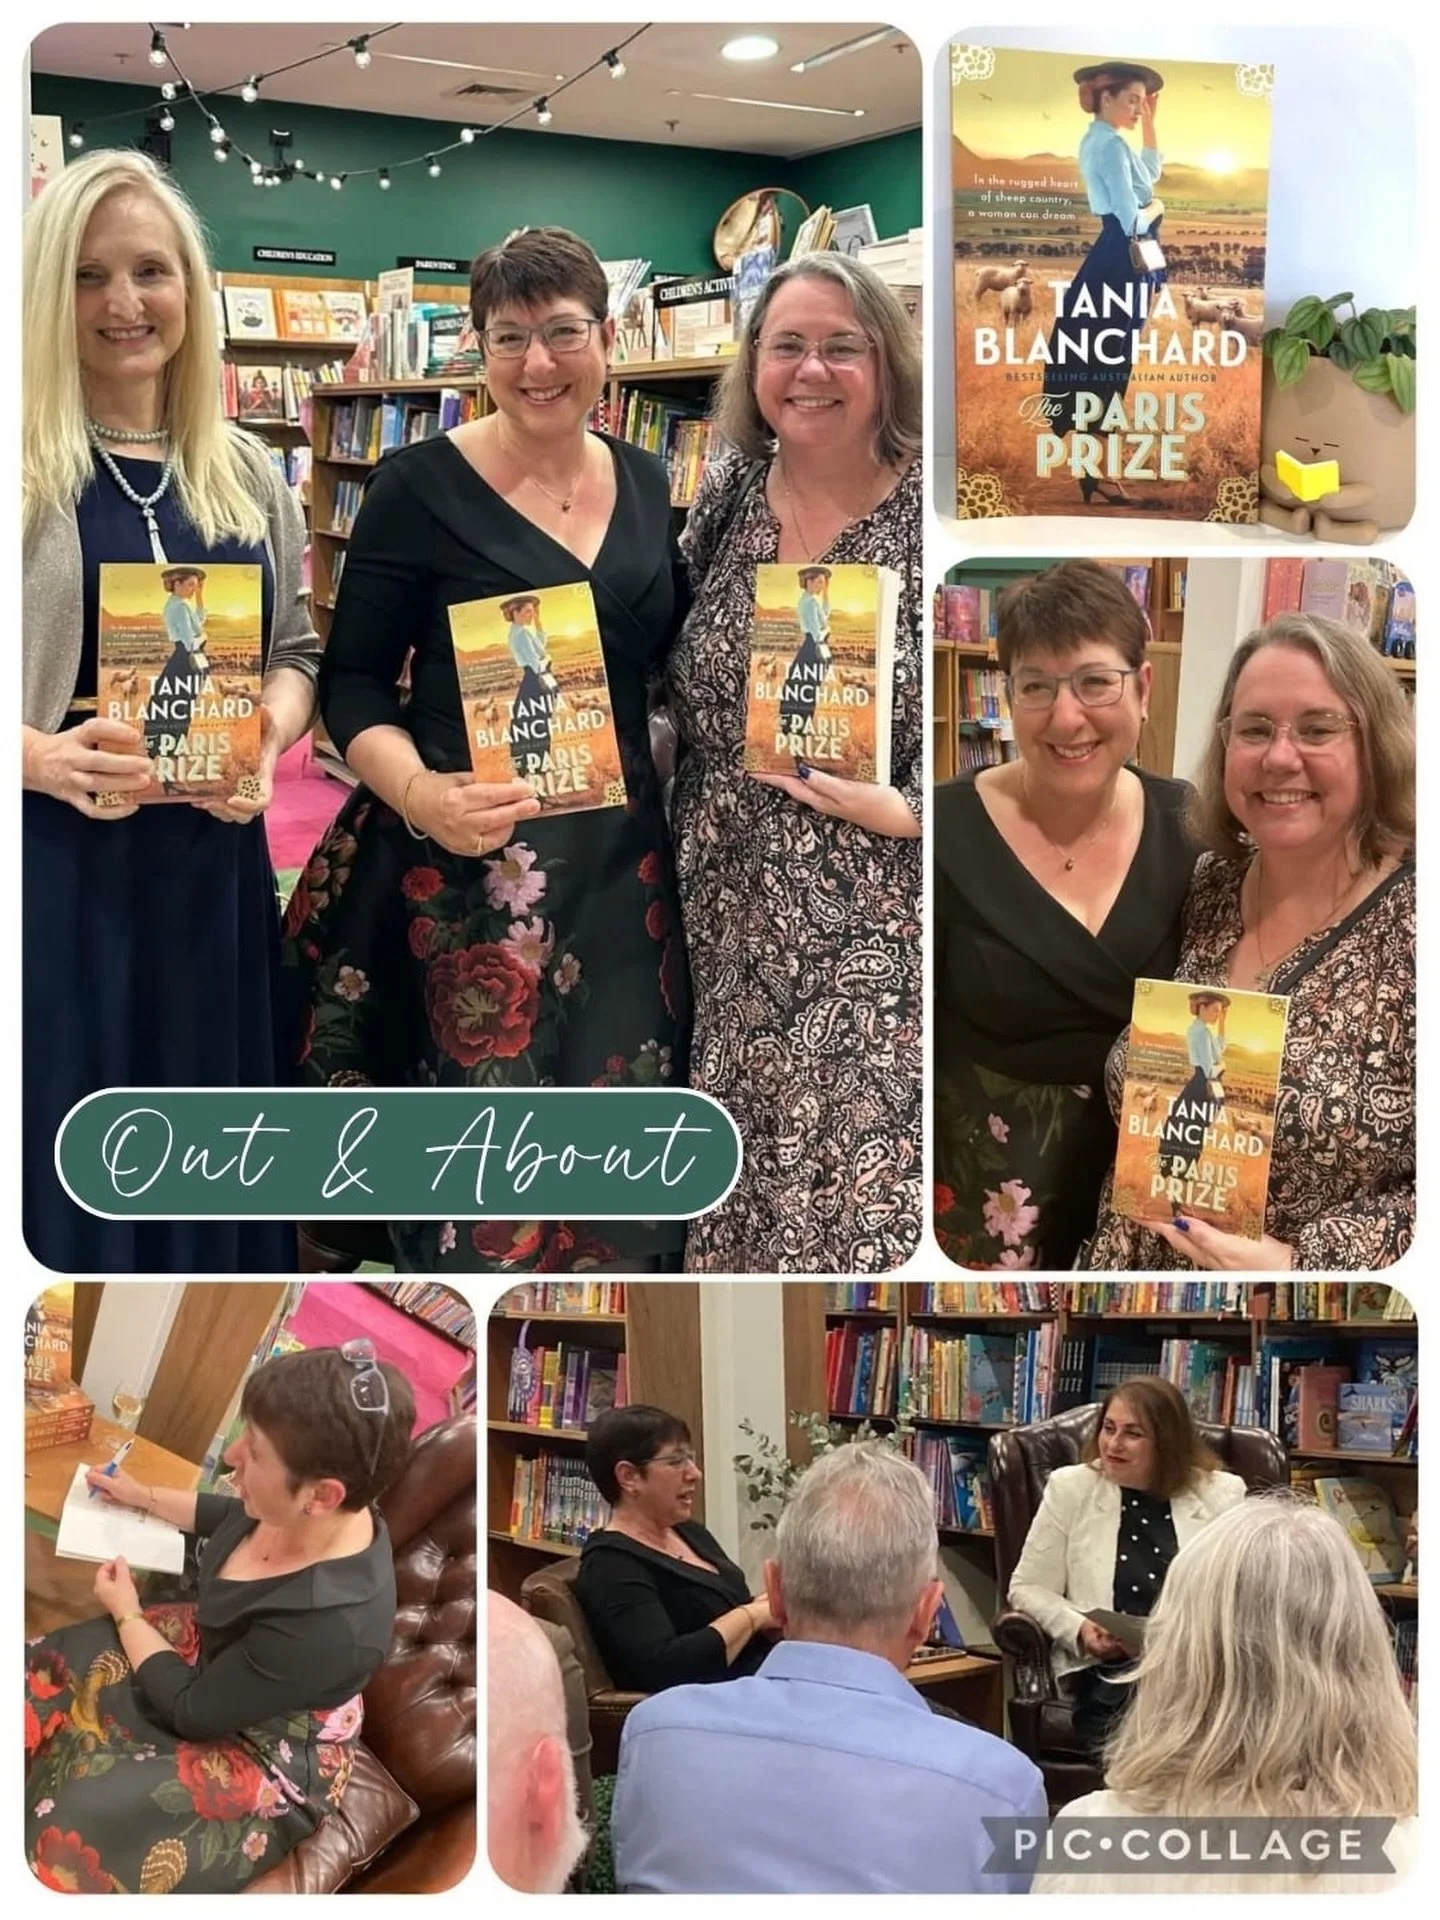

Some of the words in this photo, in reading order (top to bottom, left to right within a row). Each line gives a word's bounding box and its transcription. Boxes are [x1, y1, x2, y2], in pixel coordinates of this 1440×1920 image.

[974, 173, 985, 185] In
[988, 174, 1006, 186] the
[1009, 176, 1047, 189] rugged
[1050, 177, 1079, 189] heart
[980, 190, 992, 203] of
[995, 190, 1026, 204] sheep
[1029, 194, 1073, 206] country,
[968, 210, 976, 218] a
[979, 210, 1017, 219] woman
[1020, 211, 1040, 220] can
[1042, 208, 1077, 221] dream
[415, 260, 457, 270] PARENTING
[660, 280, 703, 300] CHILDREN'S
[1048, 280, 1178, 321] TANIA
[974, 327, 1248, 368] BLANCHARD
[1006, 372, 1090, 383] BESTSELLING
[1093, 372, 1165, 382] AUSTRALIAN
[1169, 373, 1218, 383] AUTHOR
[1018, 391, 1070, 429] The
[1072, 391, 1206, 432] PARIS
[1036, 431, 1188, 480] PRIZE
[150, 674, 216, 697] TANIA
[784, 661, 837, 683] TANIA
[506, 692, 569, 721] TANIA
[755, 683, 869, 707] BLANCHARD
[108, 698, 253, 721] BLANCHARD
[475, 709, 606, 748] BLANCHARD
[789, 713, 850, 738] PARIS
[158, 732, 232, 758] PARIS
[526, 743, 593, 774] PARIS
[775, 731, 845, 760] PRIZE
[154, 754, 223, 783] RIZE
[525, 765, 589, 797] RIZE
[1167, 1096, 1230, 1127] TANIA
[1128, 1115, 1264, 1158] BLANCHARD
[1171, 1155, 1239, 1189] PARIS
[1149, 1173, 1228, 1212] PRIZE
[25, 1354, 56, 1369] ARIS
[25, 1366, 52, 1382] IZE
